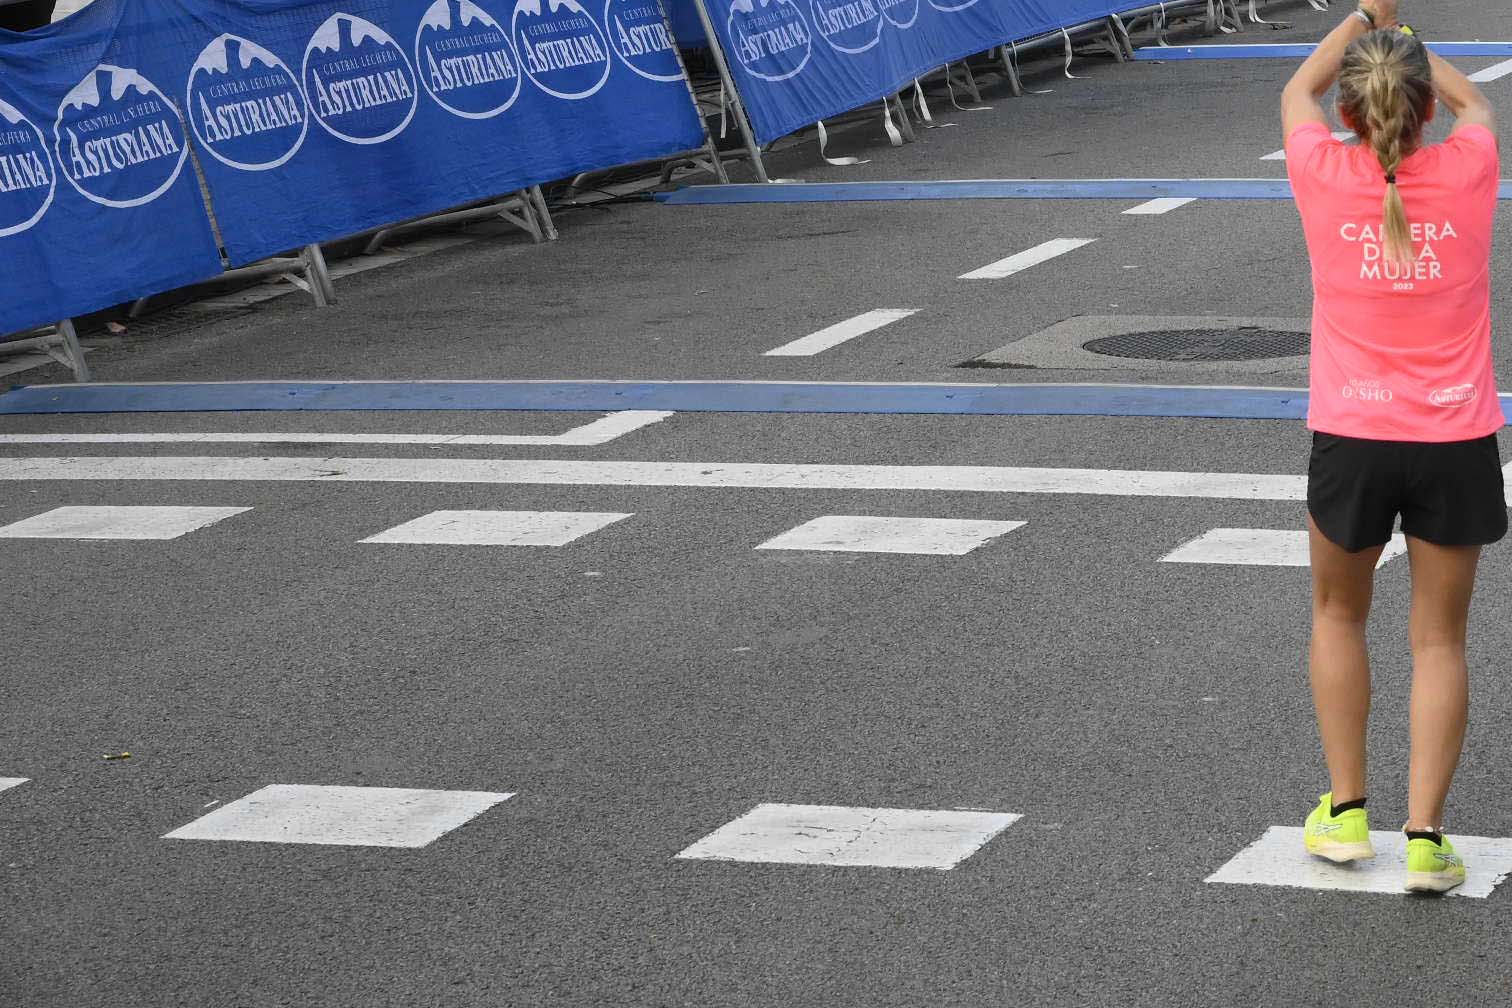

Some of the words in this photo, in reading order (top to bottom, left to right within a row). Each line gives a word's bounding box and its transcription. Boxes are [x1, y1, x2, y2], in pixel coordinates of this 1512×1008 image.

[323, 58, 360, 76] CENTRAL
[361, 50, 397, 69] LECHERA
[521, 30, 605, 75] ASTURIANA
[425, 45, 517, 93] ASTURIANA
[210, 81, 248, 98] CENTRAL
[250, 73, 287, 90] LECHERA
[312, 67, 413, 119] ASTURIANA
[199, 90, 303, 143] ASTURIANA
[67, 120, 179, 180] ASTURIANA
[1340, 221, 1457, 242] CAERA
[1363, 243, 1381, 261] D
[1359, 261, 1443, 280] MUJER
[1393, 282, 1414, 290] 2023
